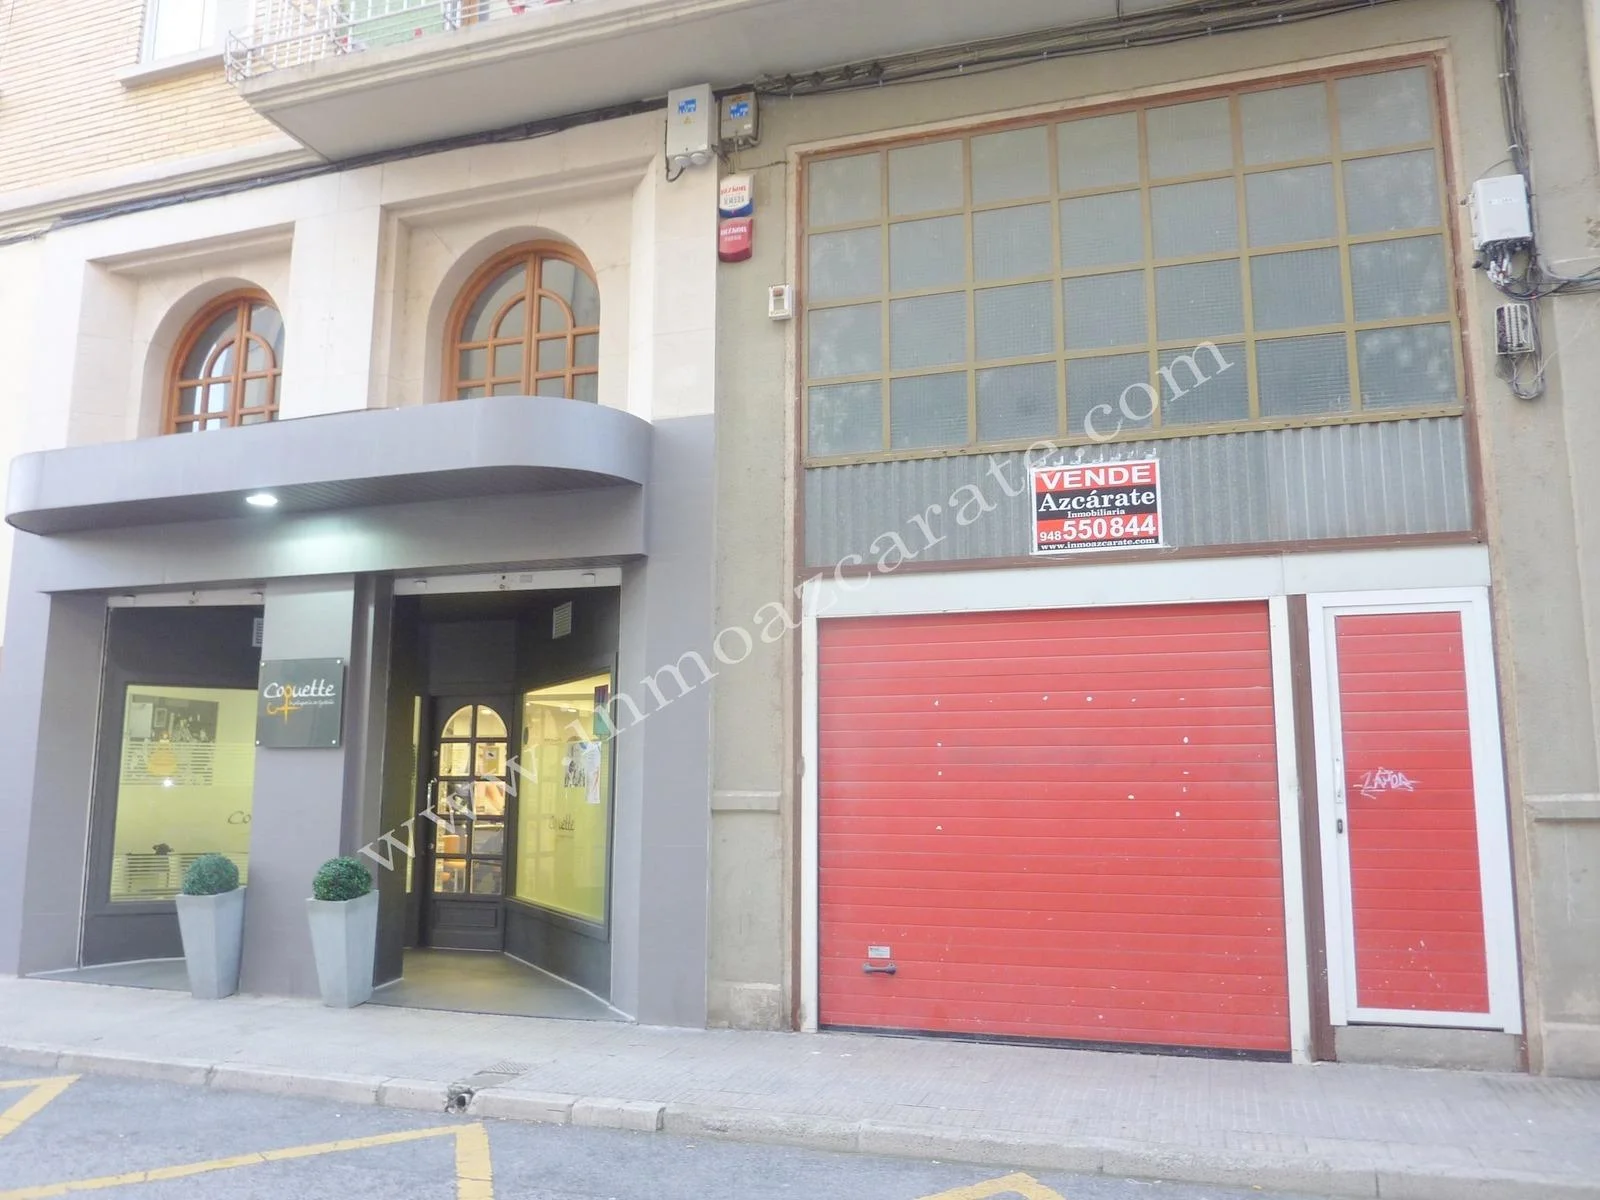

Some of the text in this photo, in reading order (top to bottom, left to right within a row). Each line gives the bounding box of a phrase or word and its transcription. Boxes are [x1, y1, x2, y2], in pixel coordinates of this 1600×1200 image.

[1039, 465, 1151, 490] VENDE
[1038, 488, 1156, 512] Azcárate
[1067, 508, 1126, 518] Inmobiliaria
[1039, 515, 1156, 542] 948 550844
[1040, 537, 1156, 551] www.inmoazcarate.com
[263, 678, 336, 709] Coquette
